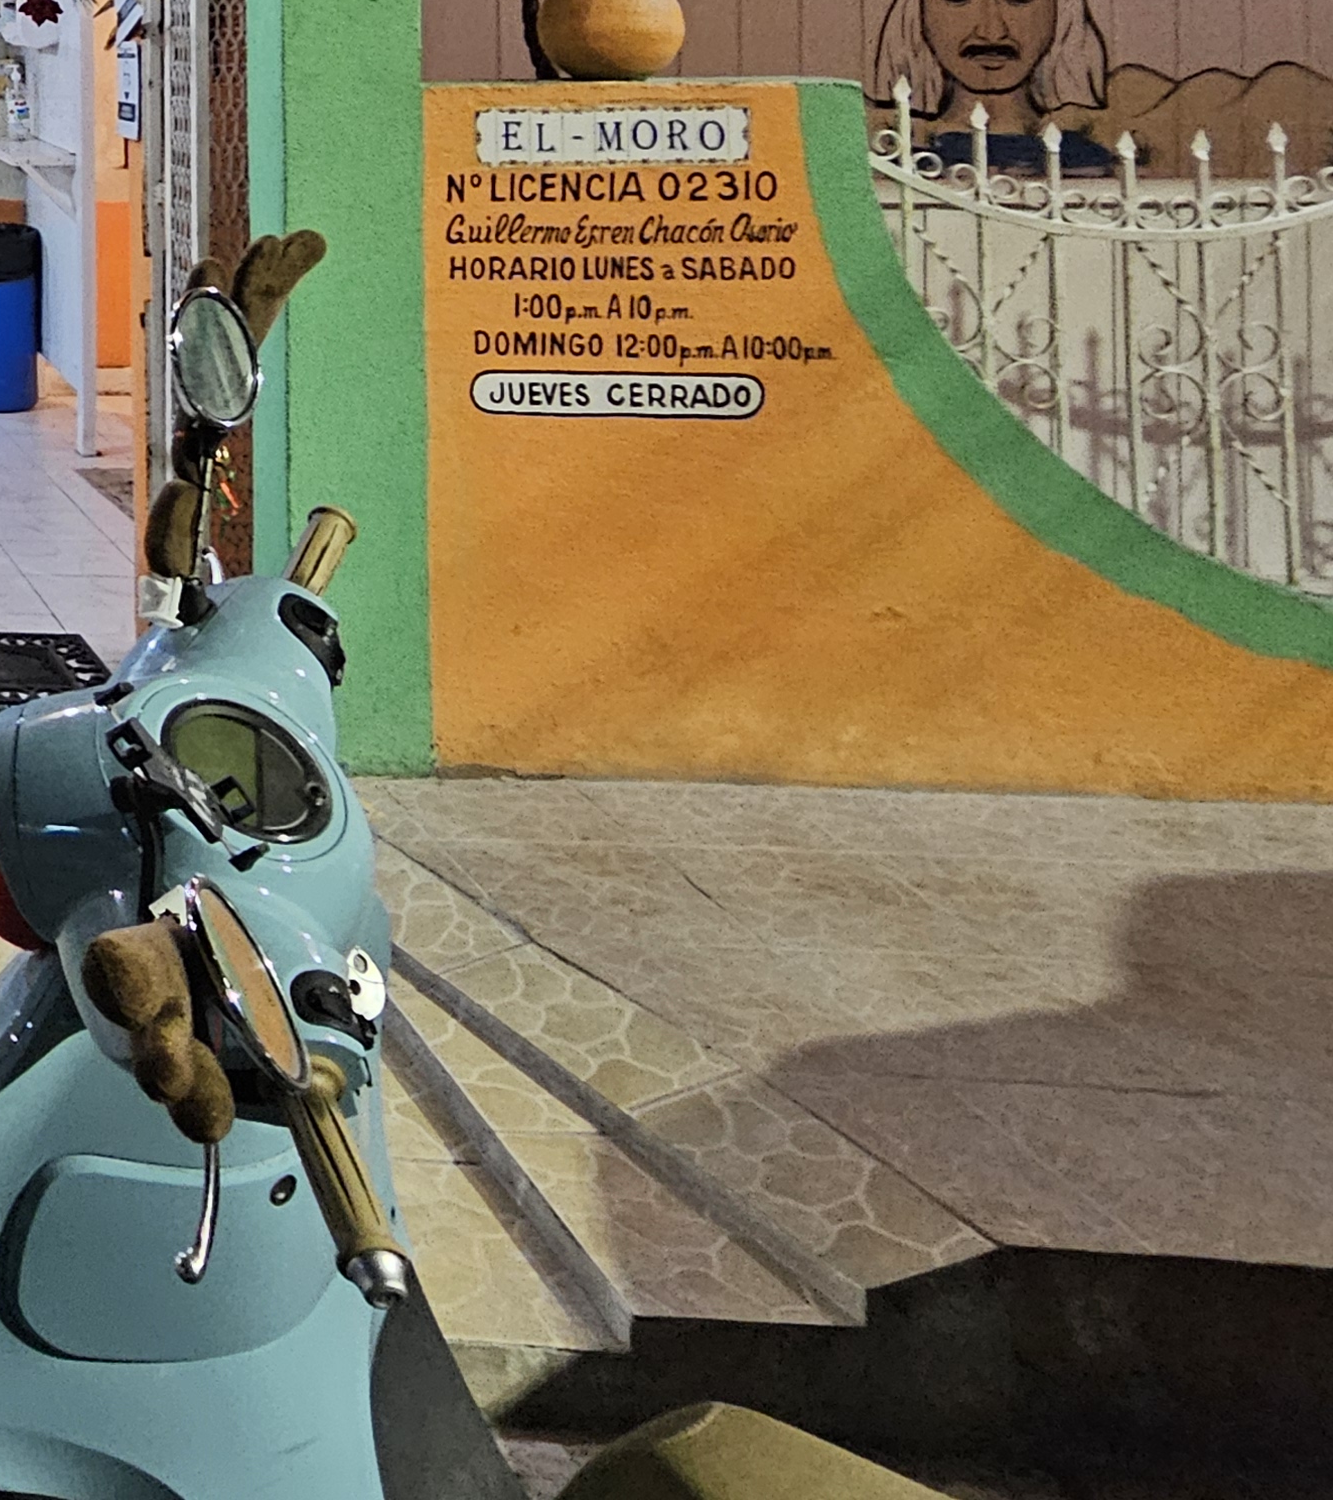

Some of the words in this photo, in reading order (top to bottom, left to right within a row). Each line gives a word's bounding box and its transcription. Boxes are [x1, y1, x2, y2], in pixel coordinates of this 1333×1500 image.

[490, 171, 646, 202] LICENCIA
[658, 170, 778, 202] 02310
[445, 212, 572, 245] Guillermo
[638, 213, 725, 245] Chacón
[449, 255, 576, 281] HORARIO
[583, 255, 655, 281] LUNES
[661, 263, 675, 280] a
[681, 256, 797, 281] SABADO
[607, 293, 622, 320] A
[473, 329, 604, 357] DOMINGO
[489, 381, 591, 408] JUEVES
[606, 381, 752, 409] CERRADO
